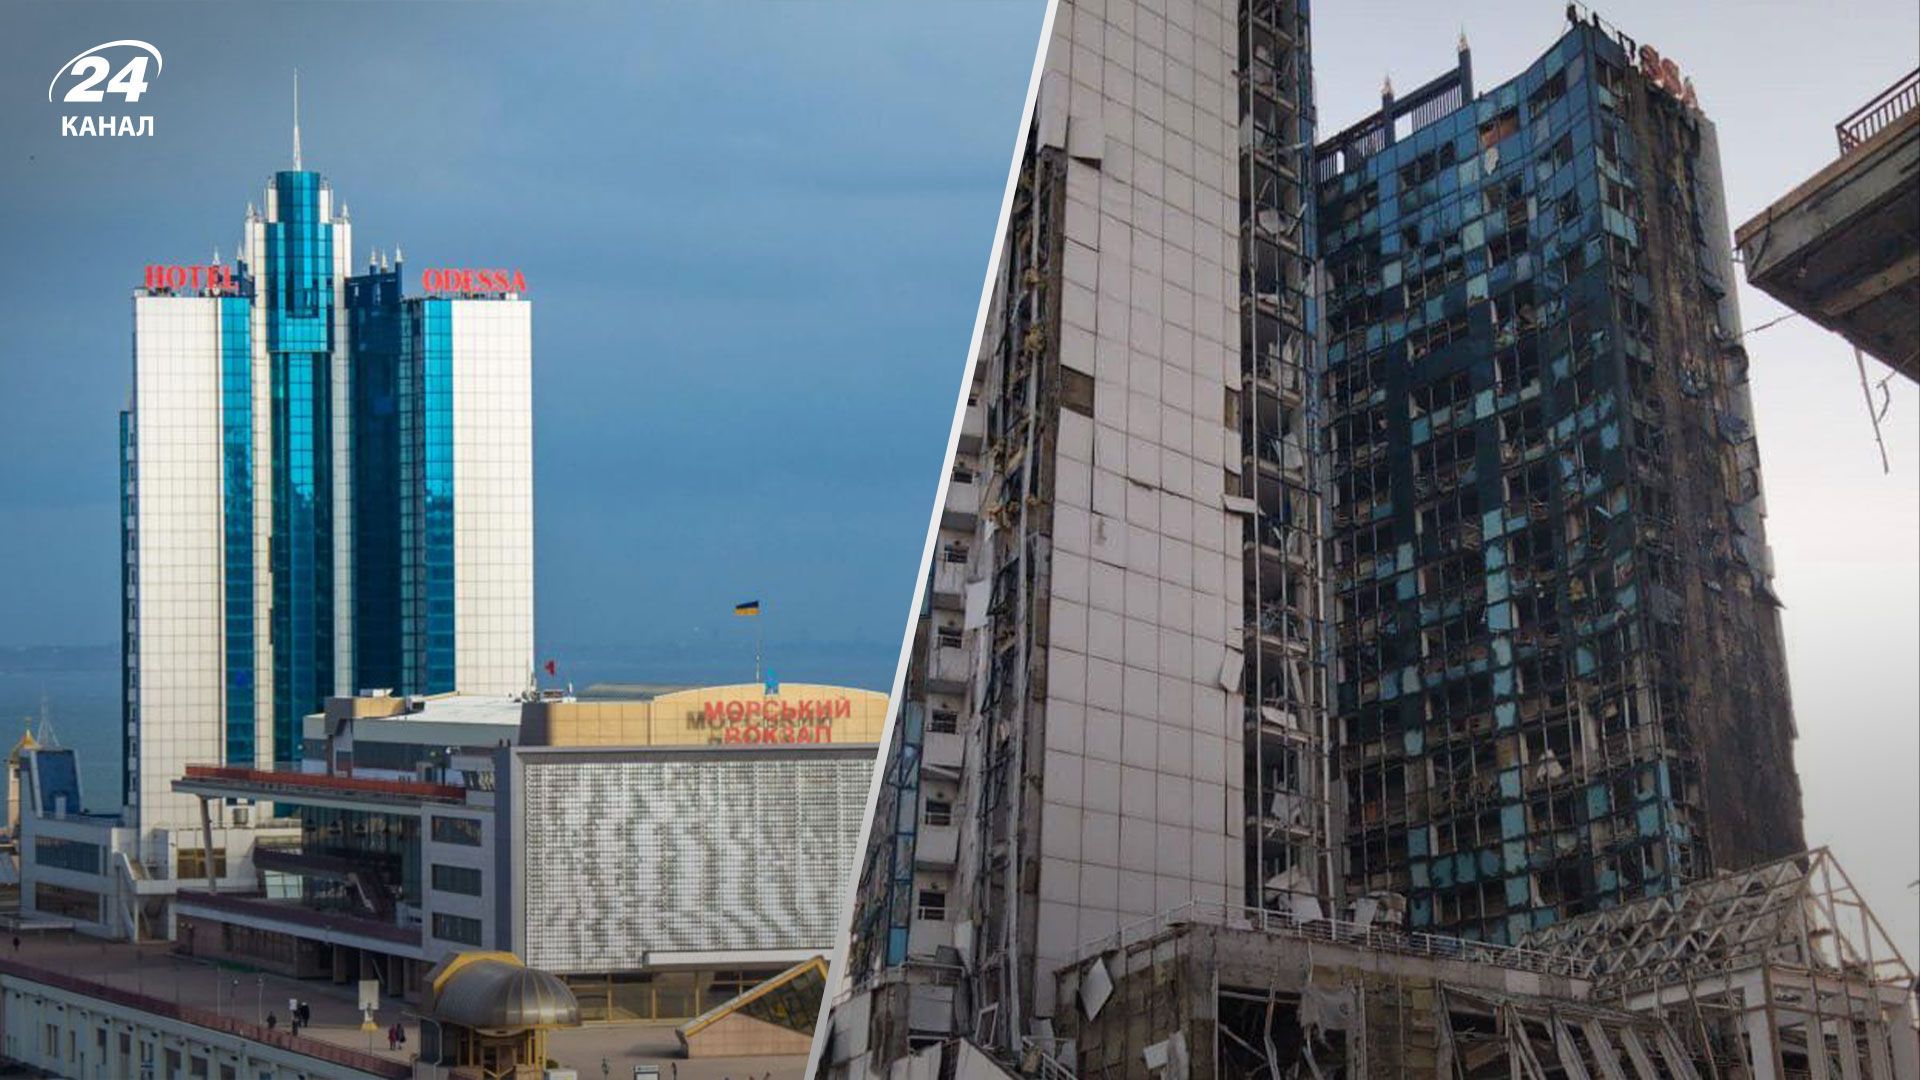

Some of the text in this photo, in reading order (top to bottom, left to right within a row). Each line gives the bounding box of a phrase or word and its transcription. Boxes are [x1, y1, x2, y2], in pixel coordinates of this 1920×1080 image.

[144, 265, 239, 290] HOTEL
[422, 267, 526, 292] ODESSA
[704, 696, 851, 723] МОРСЬКИЙ
[724, 725, 832, 744] ВОКЗАЛ
